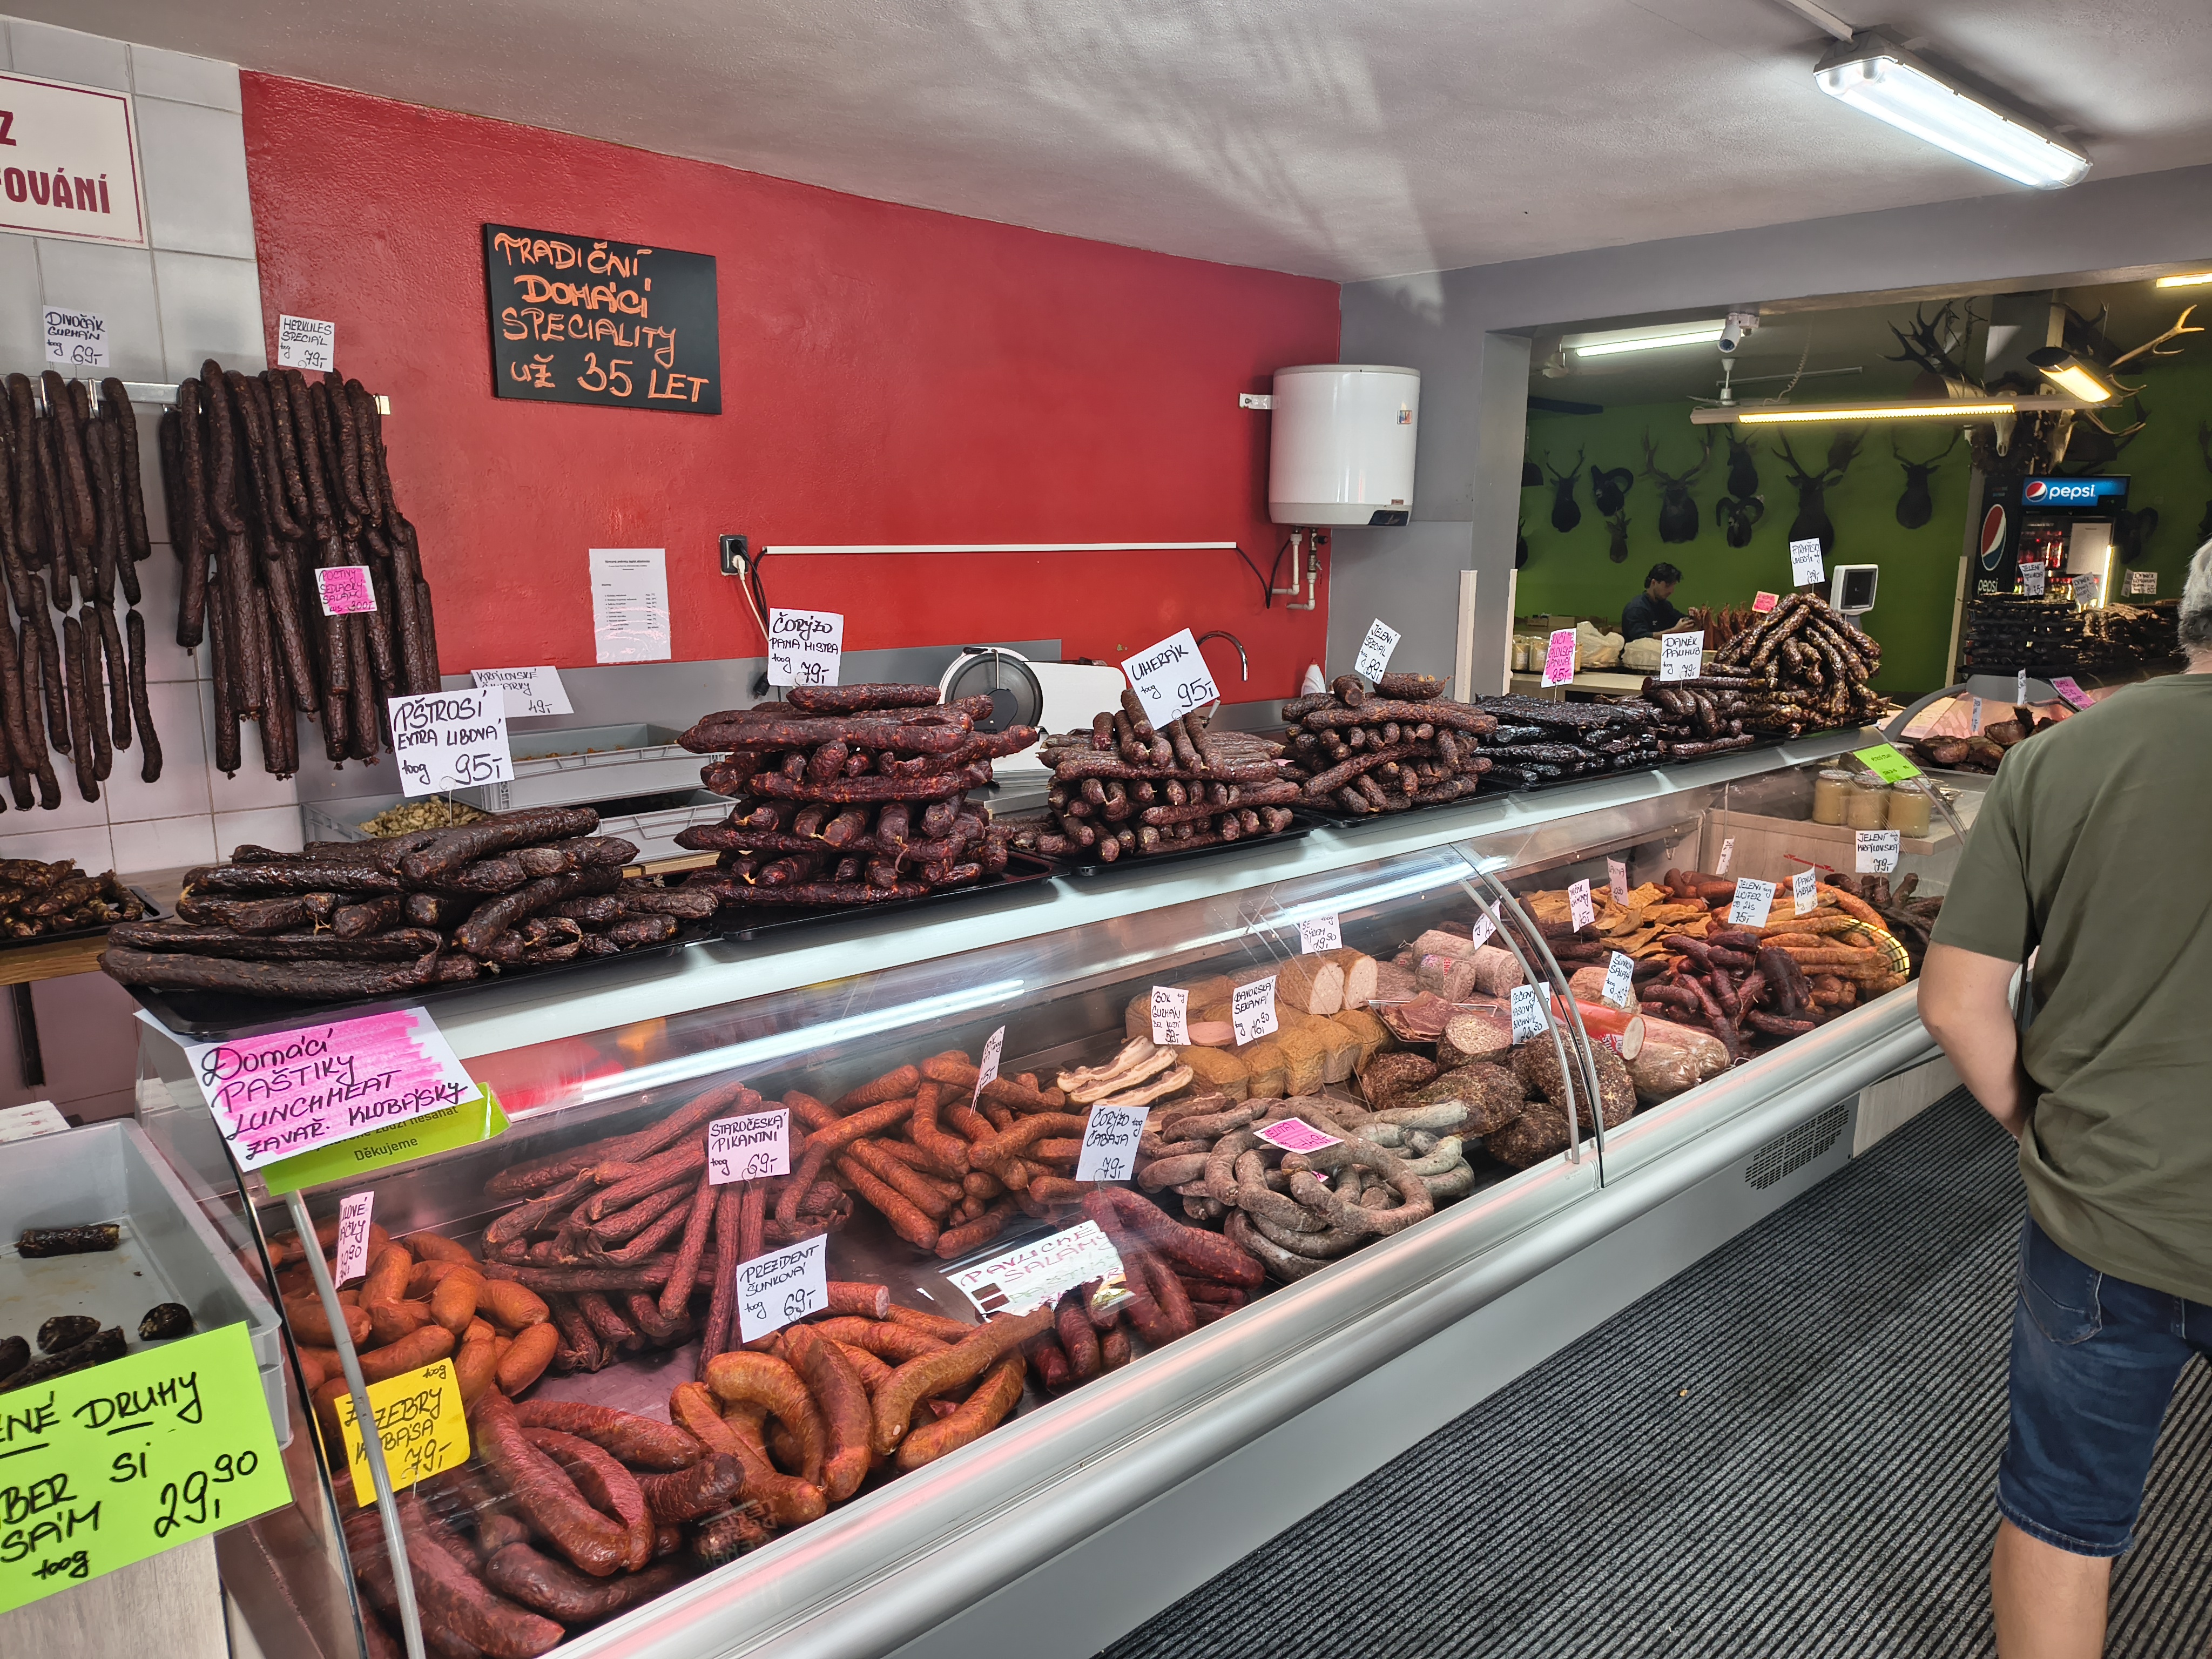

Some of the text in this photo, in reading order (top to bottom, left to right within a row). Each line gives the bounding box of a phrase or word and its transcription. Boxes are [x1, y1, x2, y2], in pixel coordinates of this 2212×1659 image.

[0, 167, 110, 214] OVÁNÍ
[494, 232, 652, 278] TRADIČNÍ
[514, 275, 651, 318] DOMÁCÍ
[45, 312, 105, 333] DIVOČÁK
[281, 331, 328, 346] SPECIÁL
[284, 318, 332, 335] HERKULES
[502, 306, 676, 370] SPECIALITY
[577, 353, 633, 397] 35
[648, 368, 709, 402] LET
[2049, 484, 2095, 500] pepsi
[1978, 578, 1999, 594] pepsi
[476, 668, 538, 682] KRÁLOVSKÉ
[1131, 644, 1189, 681] UHERÁK
[394, 690, 487, 732] PŠTROSÍ
[397, 718, 501, 751] EXTRA LIBOVÁ
[1857, 832, 1889, 842] JELENÍ
[1152, 991, 1171, 1003] BOK
[1234, 979, 1274, 1002] BAVORSKÁ
[1234, 992, 1269, 1014] SEKANÁ
[211, 1056, 354, 1113] PAŠTIKY
[225, 1069, 402, 1141] LUNCHMEAT
[348, 1082, 468, 1127] KLOBÁSKY
[710, 1112, 786, 1137] STAROČESKÁ
[712, 1124, 780, 1152] PIKANTNÍ
[354, 1137, 419, 1161] Děkujeme
[740, 1244, 820, 1283] PREZIDENT
[746, 1262, 806, 1297] ŠUNKOVÁ
[72, 1371, 203, 1424] DRUHY
